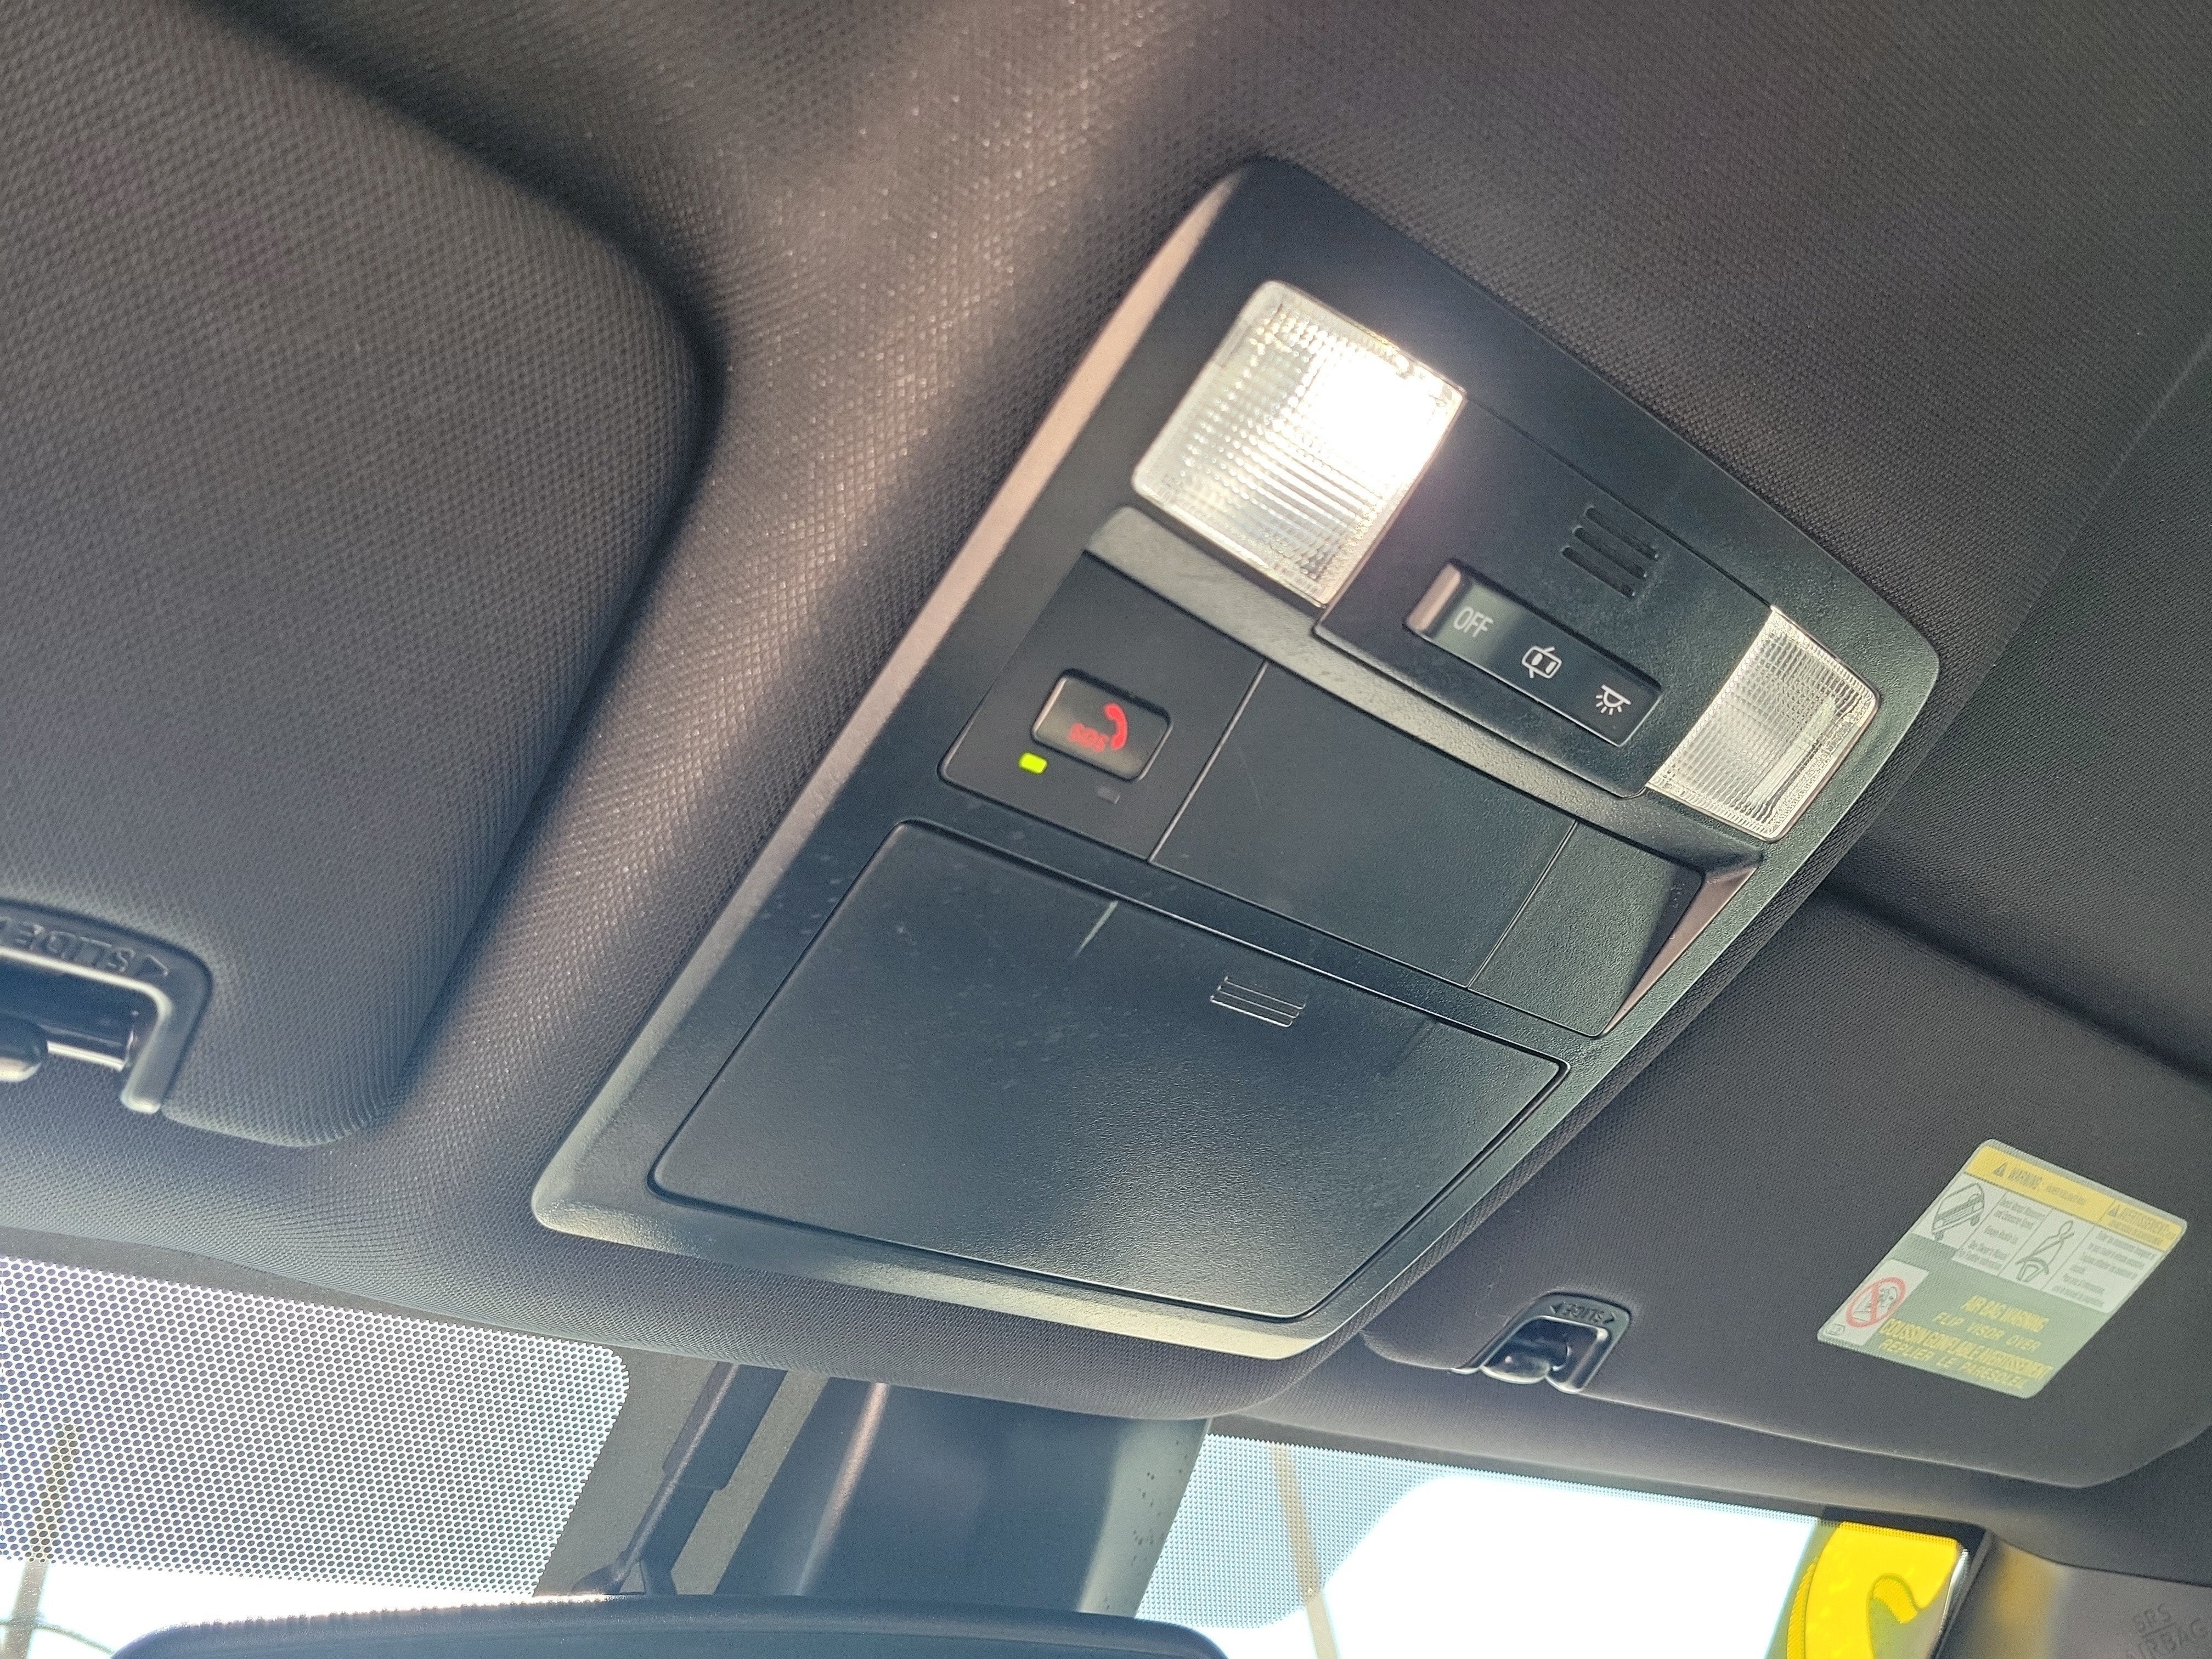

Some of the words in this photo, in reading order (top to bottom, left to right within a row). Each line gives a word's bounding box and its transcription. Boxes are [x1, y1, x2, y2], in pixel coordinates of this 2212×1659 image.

[1453, 607, 1493, 637] OFF
[1960, 1295, 1987, 1312] AIR
[1978, 1300, 2006, 1318] BAG
[1998, 1307, 2050, 1332] WARNING
[1932, 1312, 1964, 1328] FLIP
[1966, 1323, 2005, 1340] VISOR
[2006, 1335, 2041, 1351] OVER
[1878, 1318, 1929, 1343] COUSSIN
[1922, 1331, 1983, 1358] GONFLABLE
[1974, 1347, 2053, 1379] AVERTISSEMENT
[1878, 1339, 1934, 1361] REPLIER
[1936, 1355, 1957, 1368] LE
[2132, 1603, 2172, 1633] SRS
